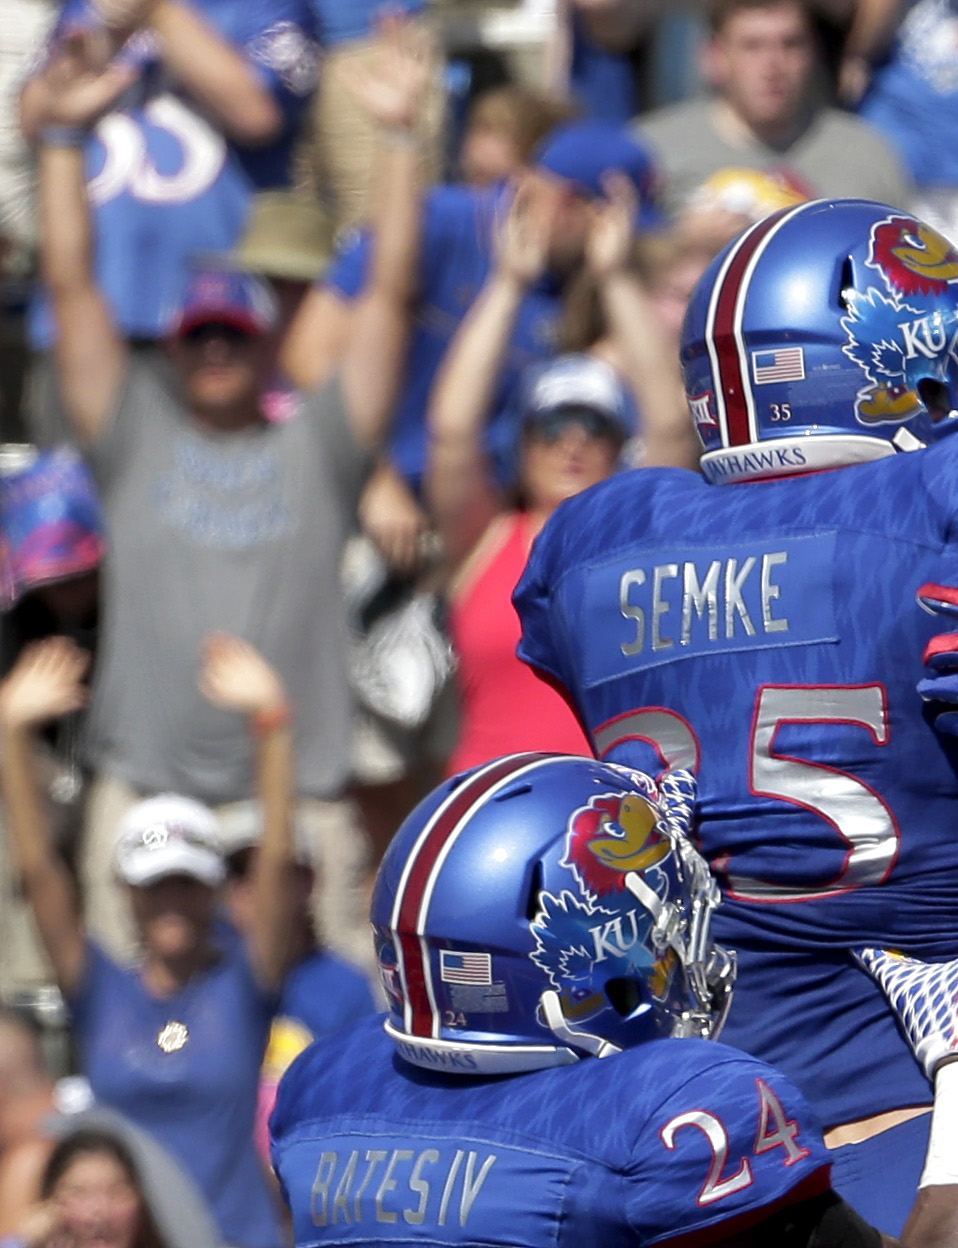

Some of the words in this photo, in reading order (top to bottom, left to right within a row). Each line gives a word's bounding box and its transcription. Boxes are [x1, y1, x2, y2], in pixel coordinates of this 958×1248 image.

[897, 309, 947, 360] KU
[769, 403, 791, 421] 35
[619, 551, 790, 657] SEMKE
[588, 909, 639, 963] KU
[445, 1010, 468, 1026] 24
[659, 1078, 813, 1207] 24
[311, 1149, 440, 1227] BATES
[437, 1149, 497, 1227] IV
